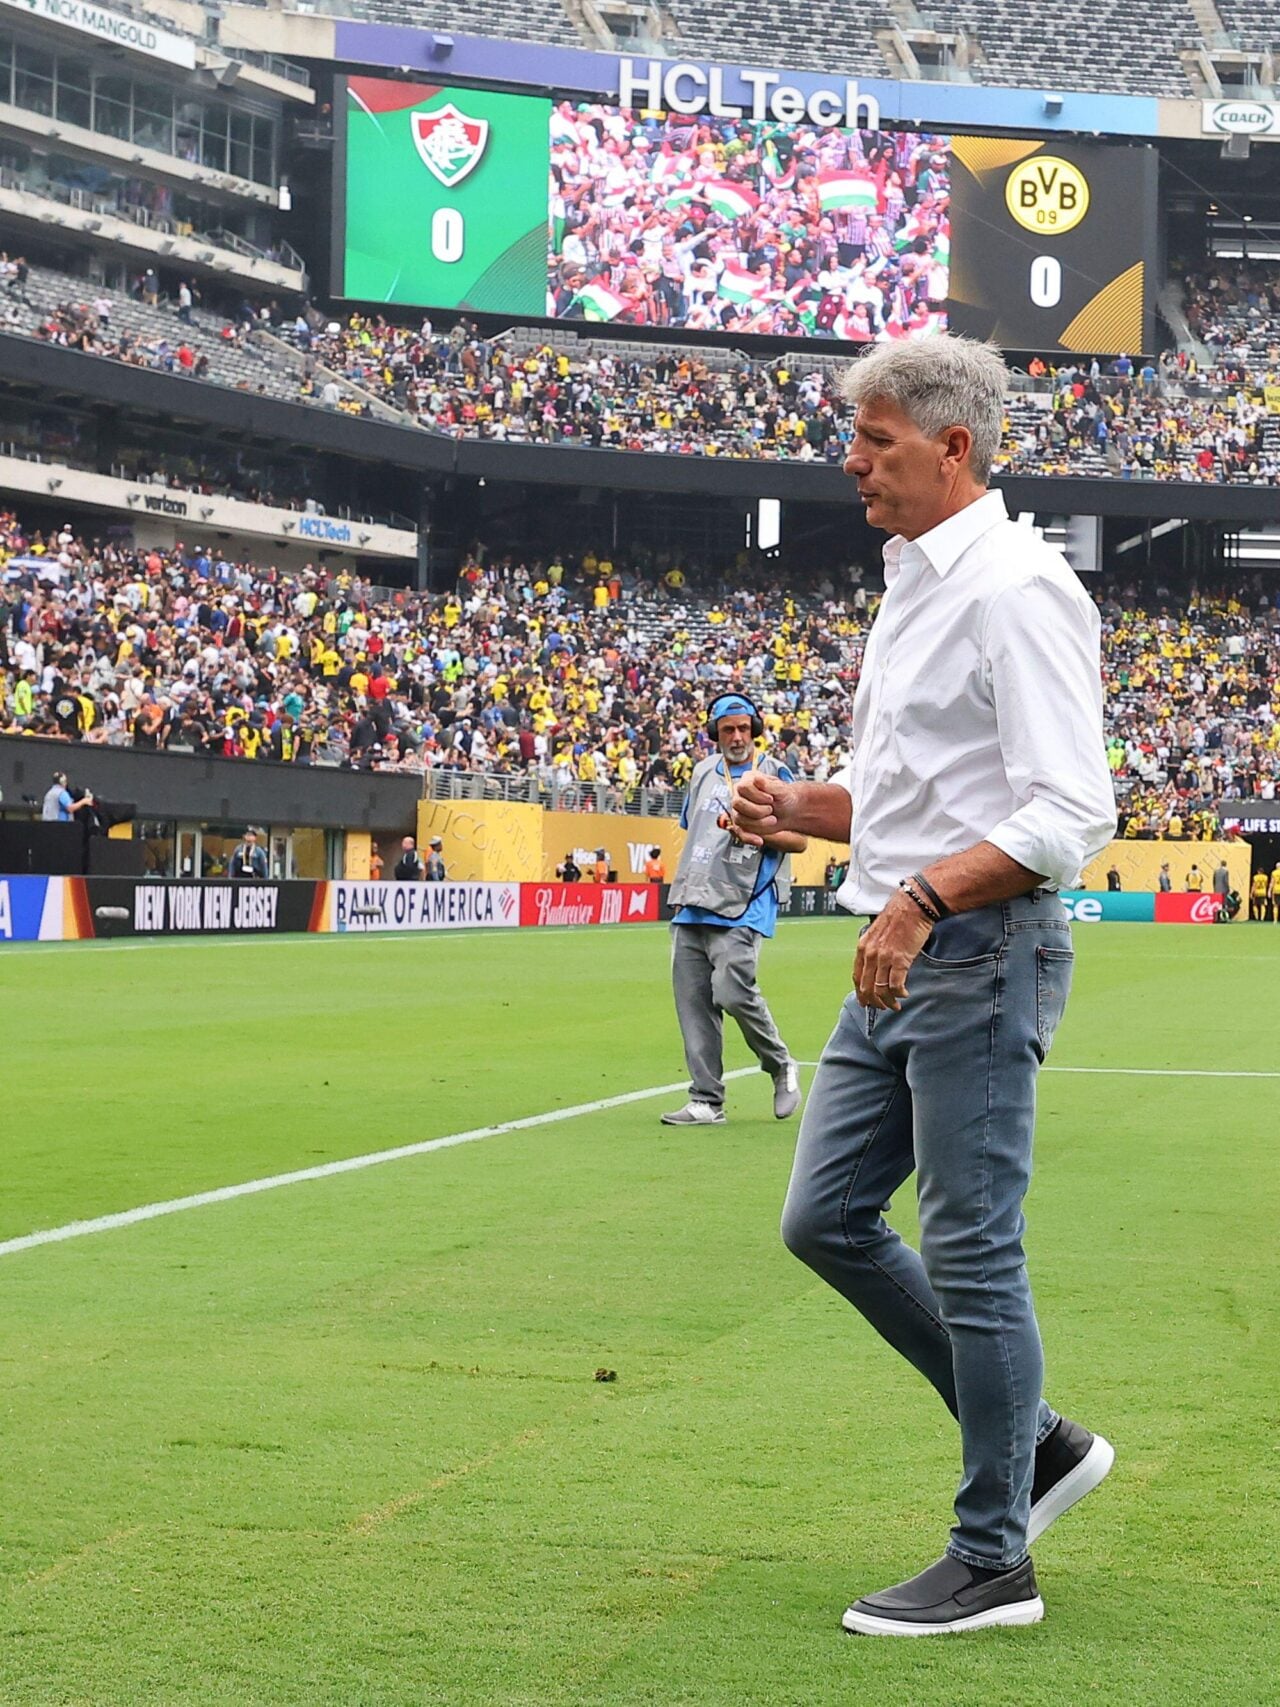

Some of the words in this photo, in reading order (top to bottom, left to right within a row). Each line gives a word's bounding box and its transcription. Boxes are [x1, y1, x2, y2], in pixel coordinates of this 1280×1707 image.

[82, 9, 157, 50] MANGOLD
[619, 58, 881, 131] HCLTech
[1219, 111, 1267, 124] COACH
[1020, 166, 1077, 210] BVB
[431, 207, 464, 263] 0
[1036, 209, 1057, 225] 09
[1030, 255, 1061, 308] 0
[144, 494, 187, 516] verizon
[300, 517, 350, 542] HCLTech
[134, 885, 166, 930] NEW
[168, 886, 201, 929] YORK
[203, 886, 233, 928] NEW
[234, 886, 279, 928] JERSEY
[337, 887, 388, 924] BANK
[394, 887, 416, 922] OF
[420, 887, 494, 923] AMERICA
[535, 888, 594, 925] Budweiser
[600, 888, 623, 924] ZERO
